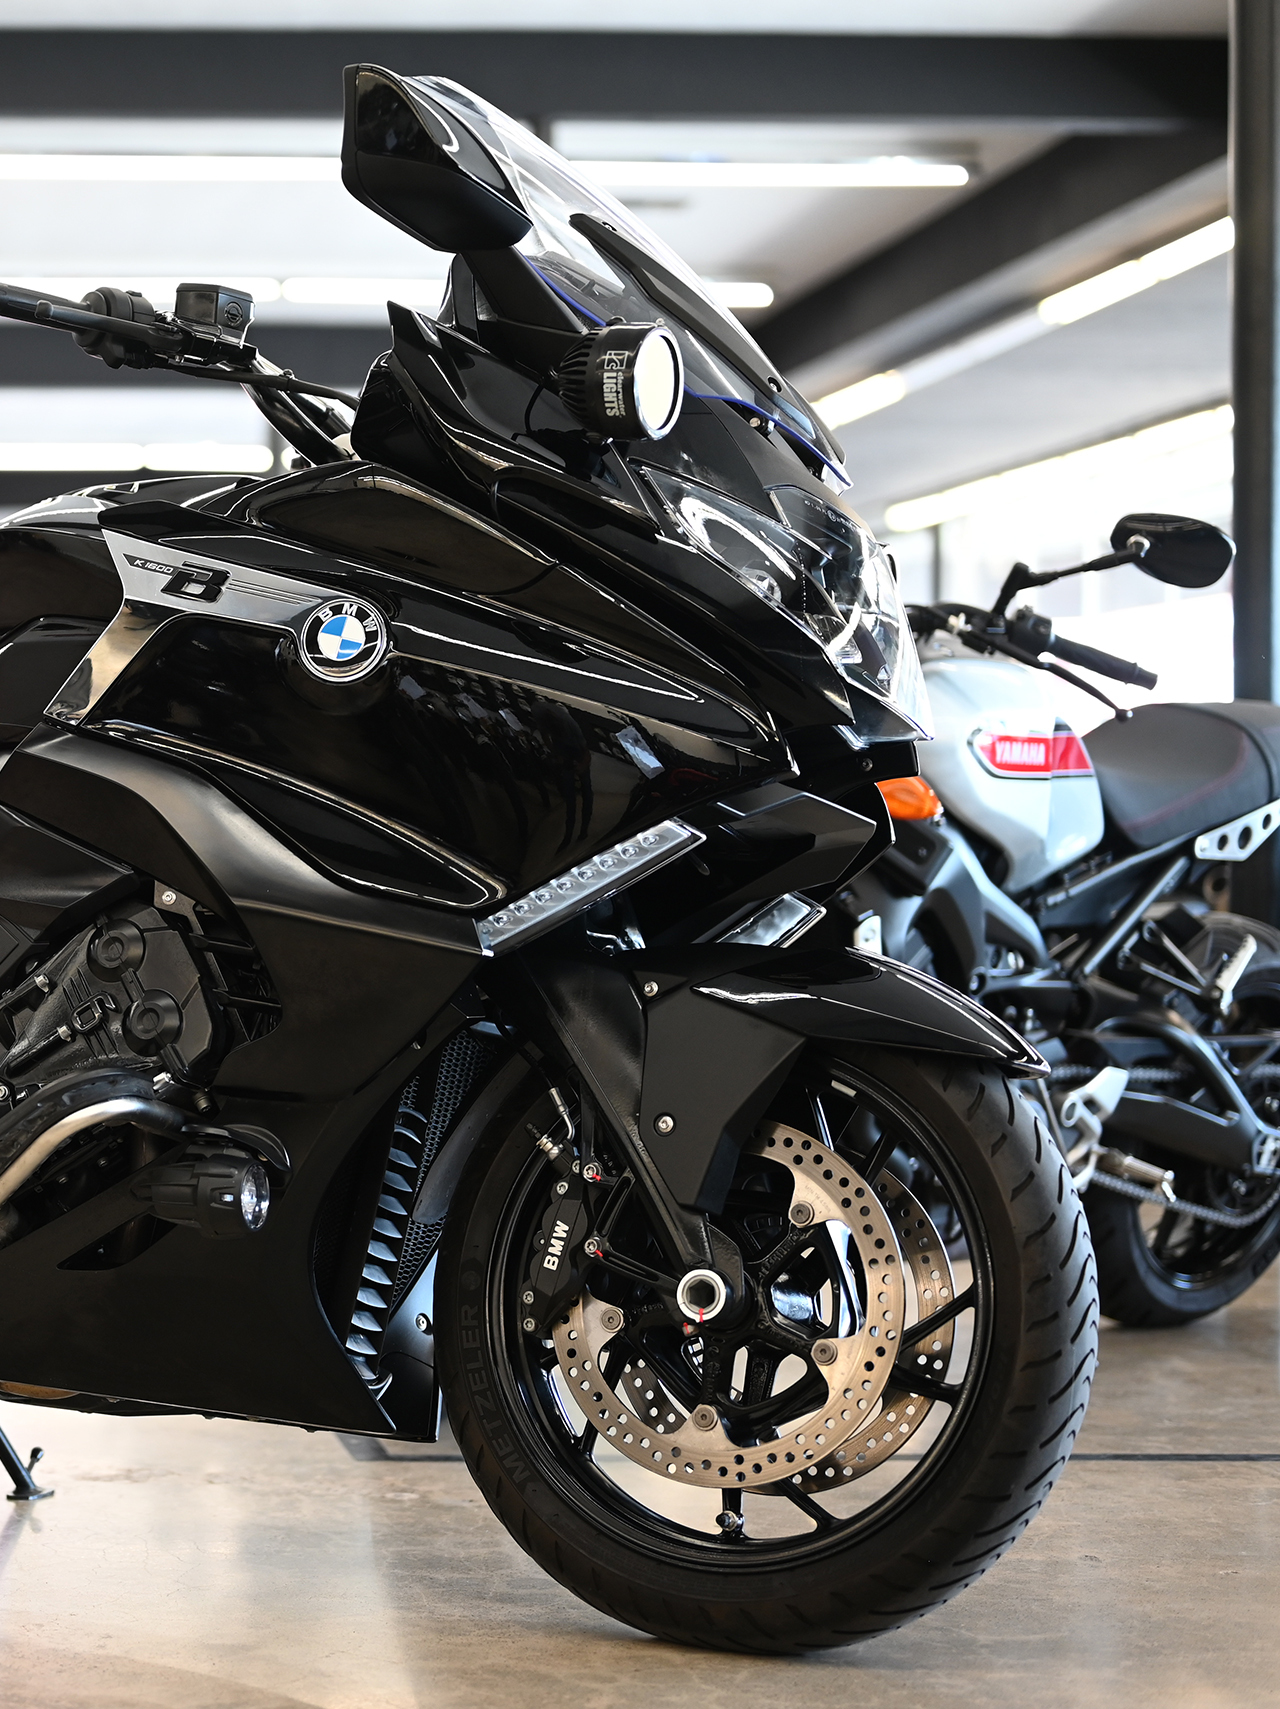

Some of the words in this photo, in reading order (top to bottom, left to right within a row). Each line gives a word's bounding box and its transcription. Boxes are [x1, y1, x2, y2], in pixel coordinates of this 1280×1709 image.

[603, 372, 620, 417] LIGHTS
[145, 562, 174, 574] 1600
[317, 602, 378, 632] BMW
[995, 741, 1046, 766] YAMAHA
[543, 1220, 570, 1271] BMW
[461, 1303, 531, 1484] METZELER
